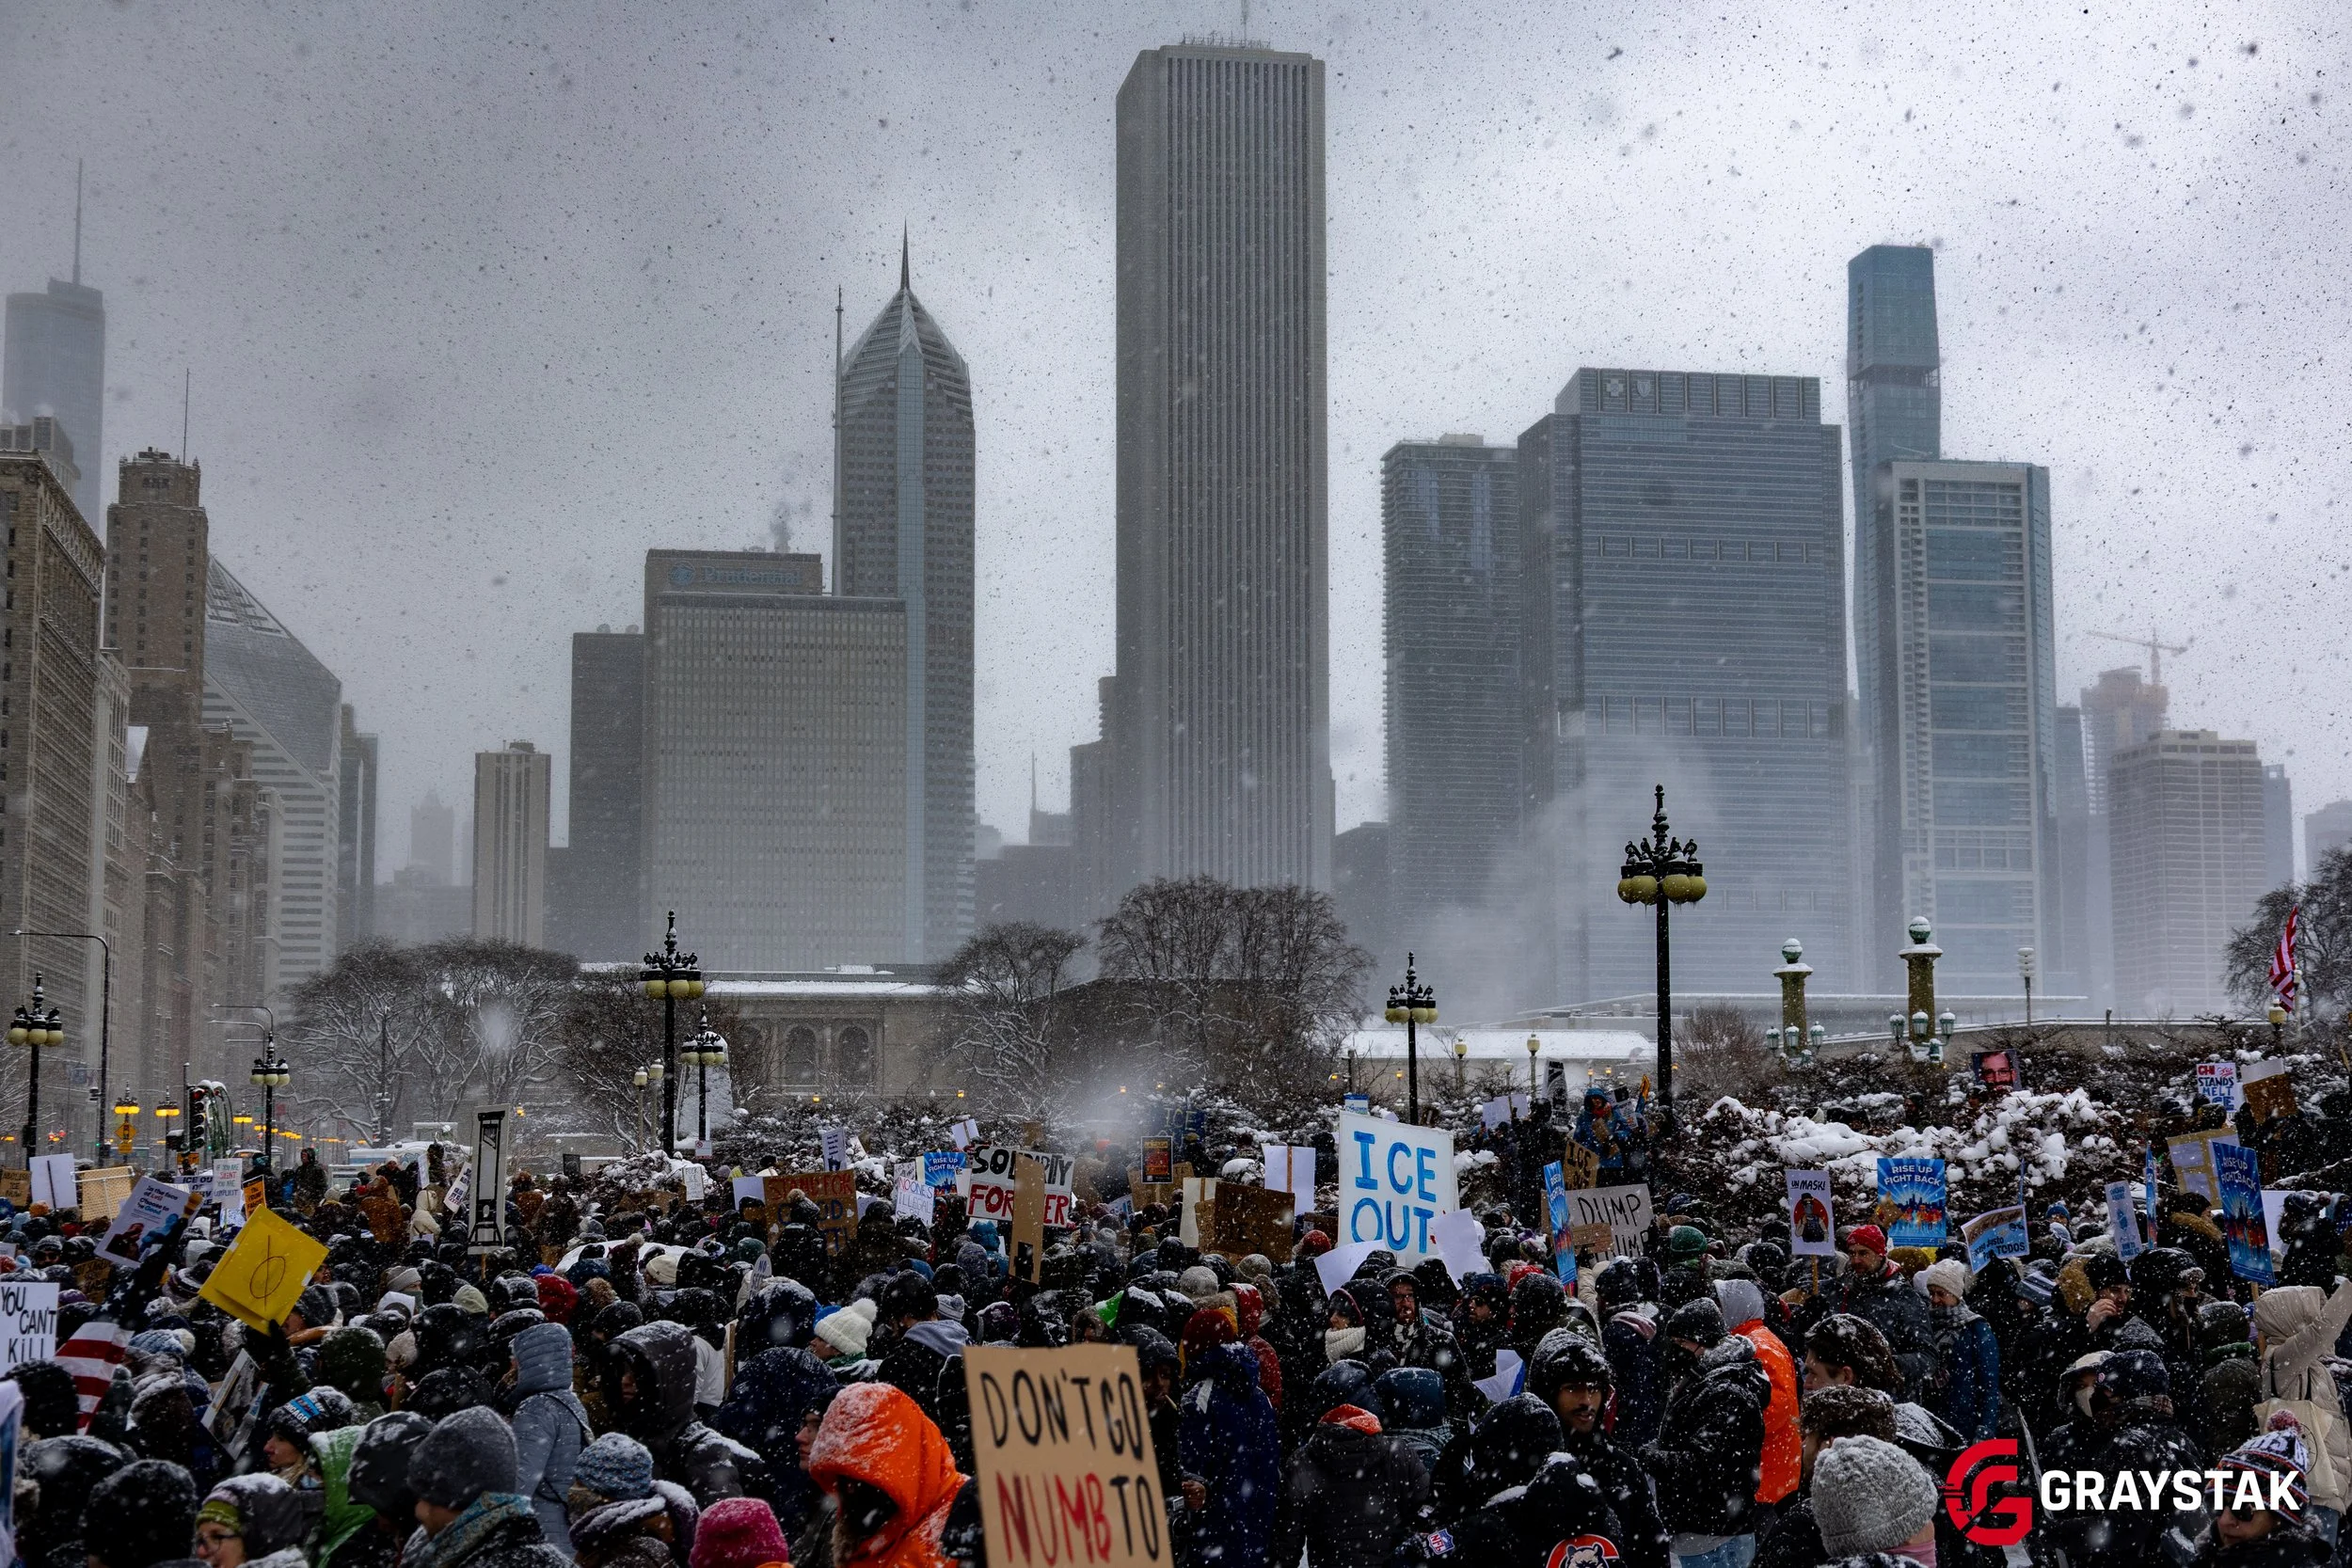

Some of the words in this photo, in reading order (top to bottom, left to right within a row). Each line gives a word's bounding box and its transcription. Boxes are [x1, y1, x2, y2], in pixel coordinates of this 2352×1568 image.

[702, 565, 802, 585] Prudential
[2198, 1077, 2233, 1086] STANDS
[2202, 1086, 2233, 1096] MELT
[929, 1164, 946, 1173] FIGHT
[1354, 1131, 1436, 1203] ICE
[1567, 1141, 1592, 1178] ICE
[1892, 1165, 1915, 1174] RISE
[824, 1173, 852, 1196] FOR
[1884, 1175, 1913, 1185] FIGHT
[1915, 1175, 1942, 1186] BACK
[165, 1192, 178, 1200] face
[898, 1192, 931, 1213] ILLEGAL
[968, 1184, 1070, 1226] FORER
[1578, 1194, 1642, 1227] DUMP
[1351, 1197, 1435, 1254] OUT
[1996, 1242, 2026, 1254] TODOS
[1, 1286, 26, 1317] YOU
[19, 1307, 56, 1335] CAN'T
[283, 1402, 310, 1423] CHICAGO
[980, 1369, 1096, 1451] DON'T
[1101, 1372, 1143, 1462] GO
[995, 1471, 1112, 1568] NUMB
[1110, 1474, 1159, 1561] TO
